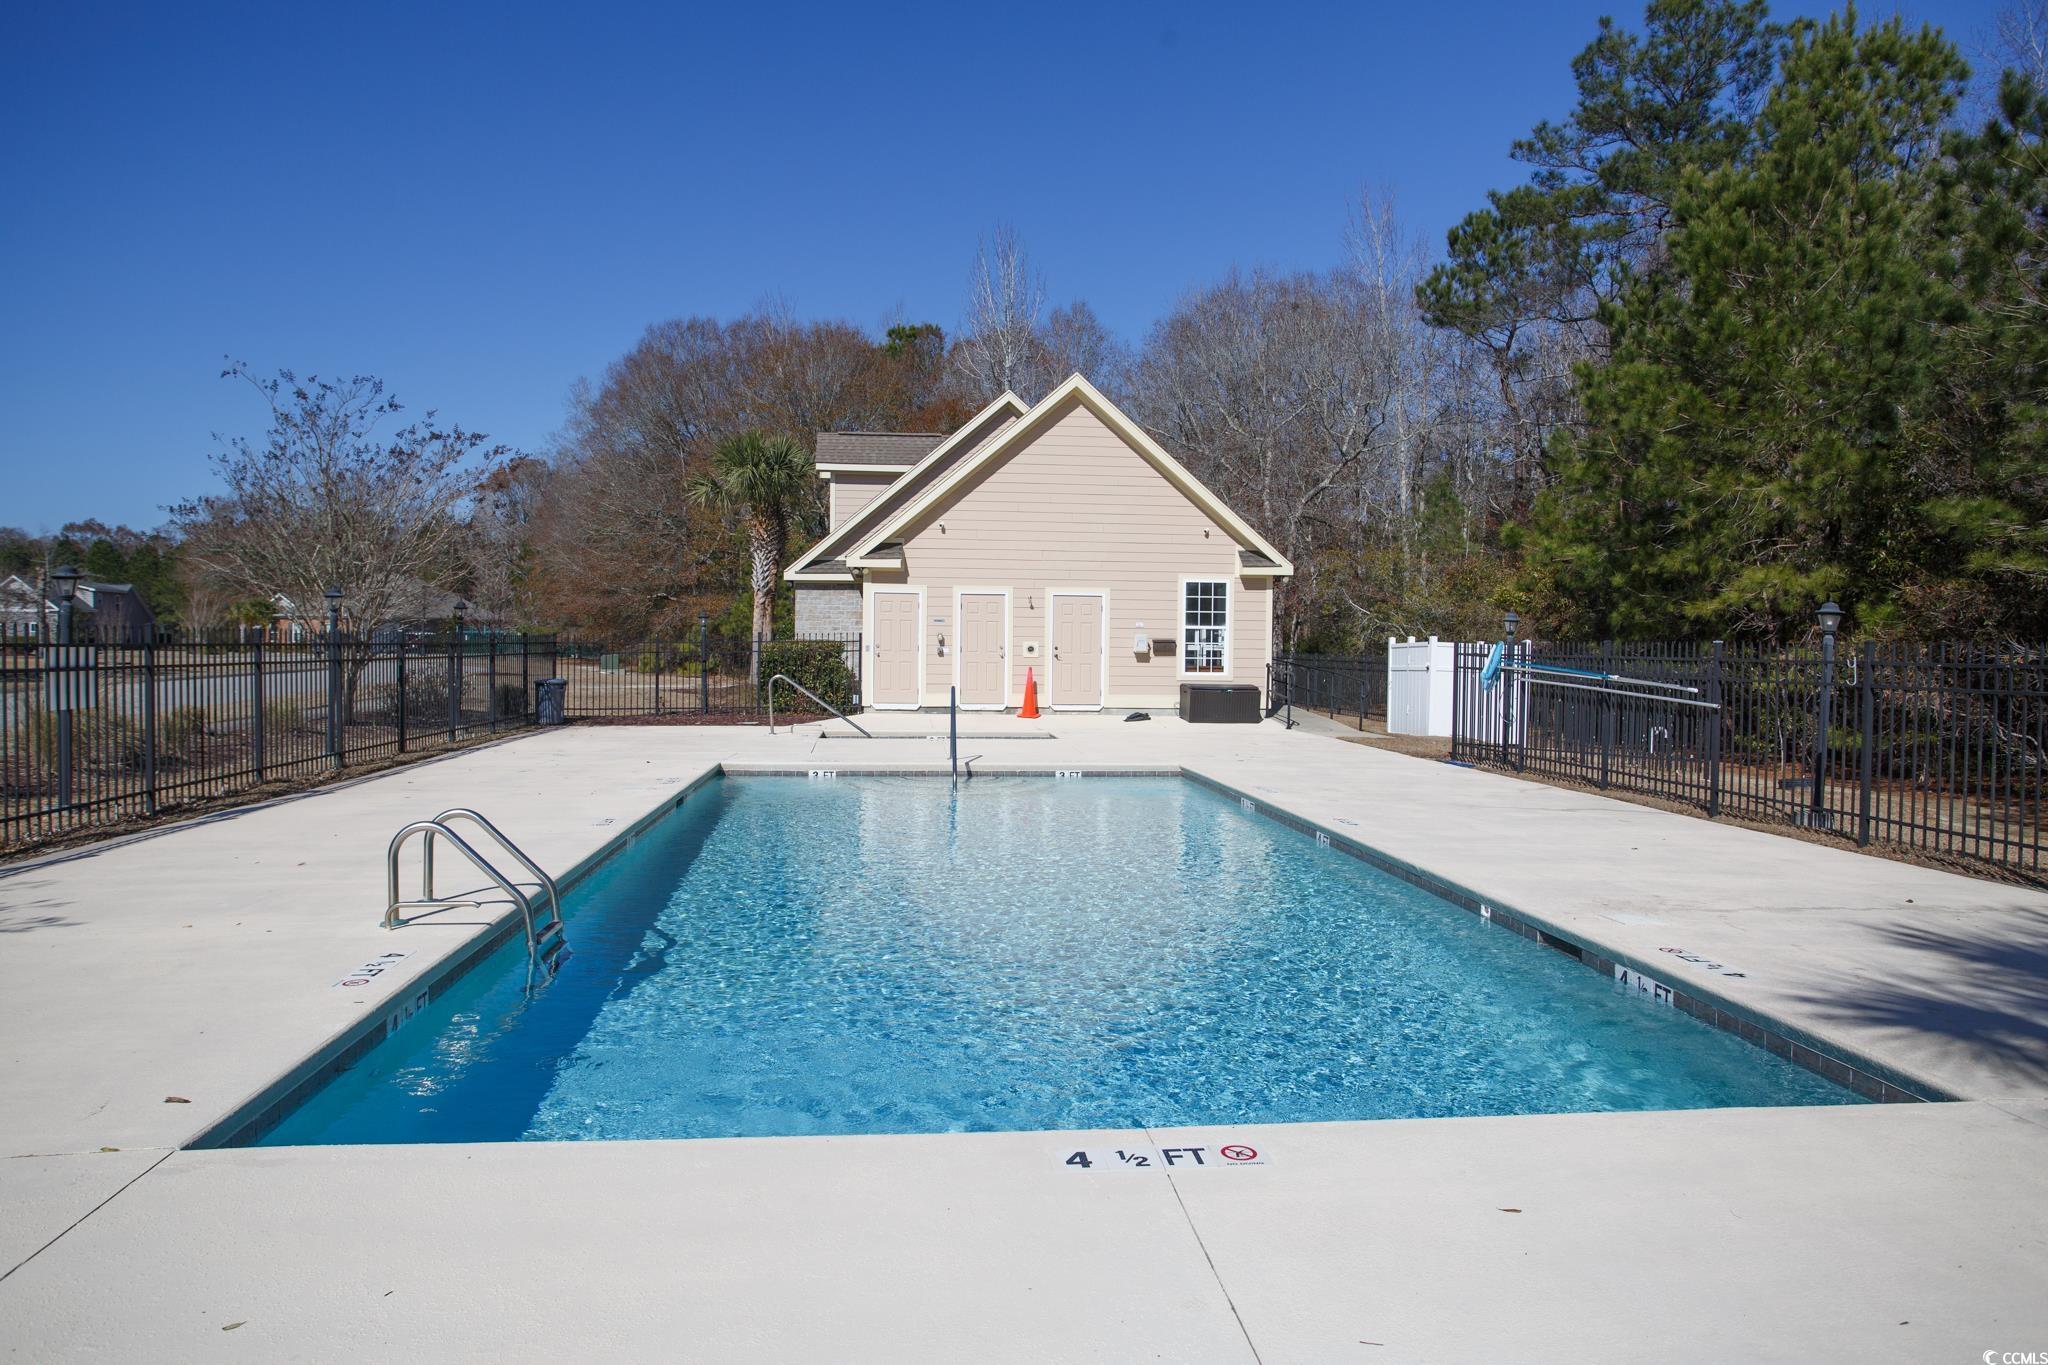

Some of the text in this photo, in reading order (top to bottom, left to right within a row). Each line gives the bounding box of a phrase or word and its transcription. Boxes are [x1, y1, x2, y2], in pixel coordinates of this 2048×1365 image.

[1654, 983, 1672, 1003] FT
[1065, 1151, 1093, 1168] 4
[1161, 1147, 1206, 1166] FT
